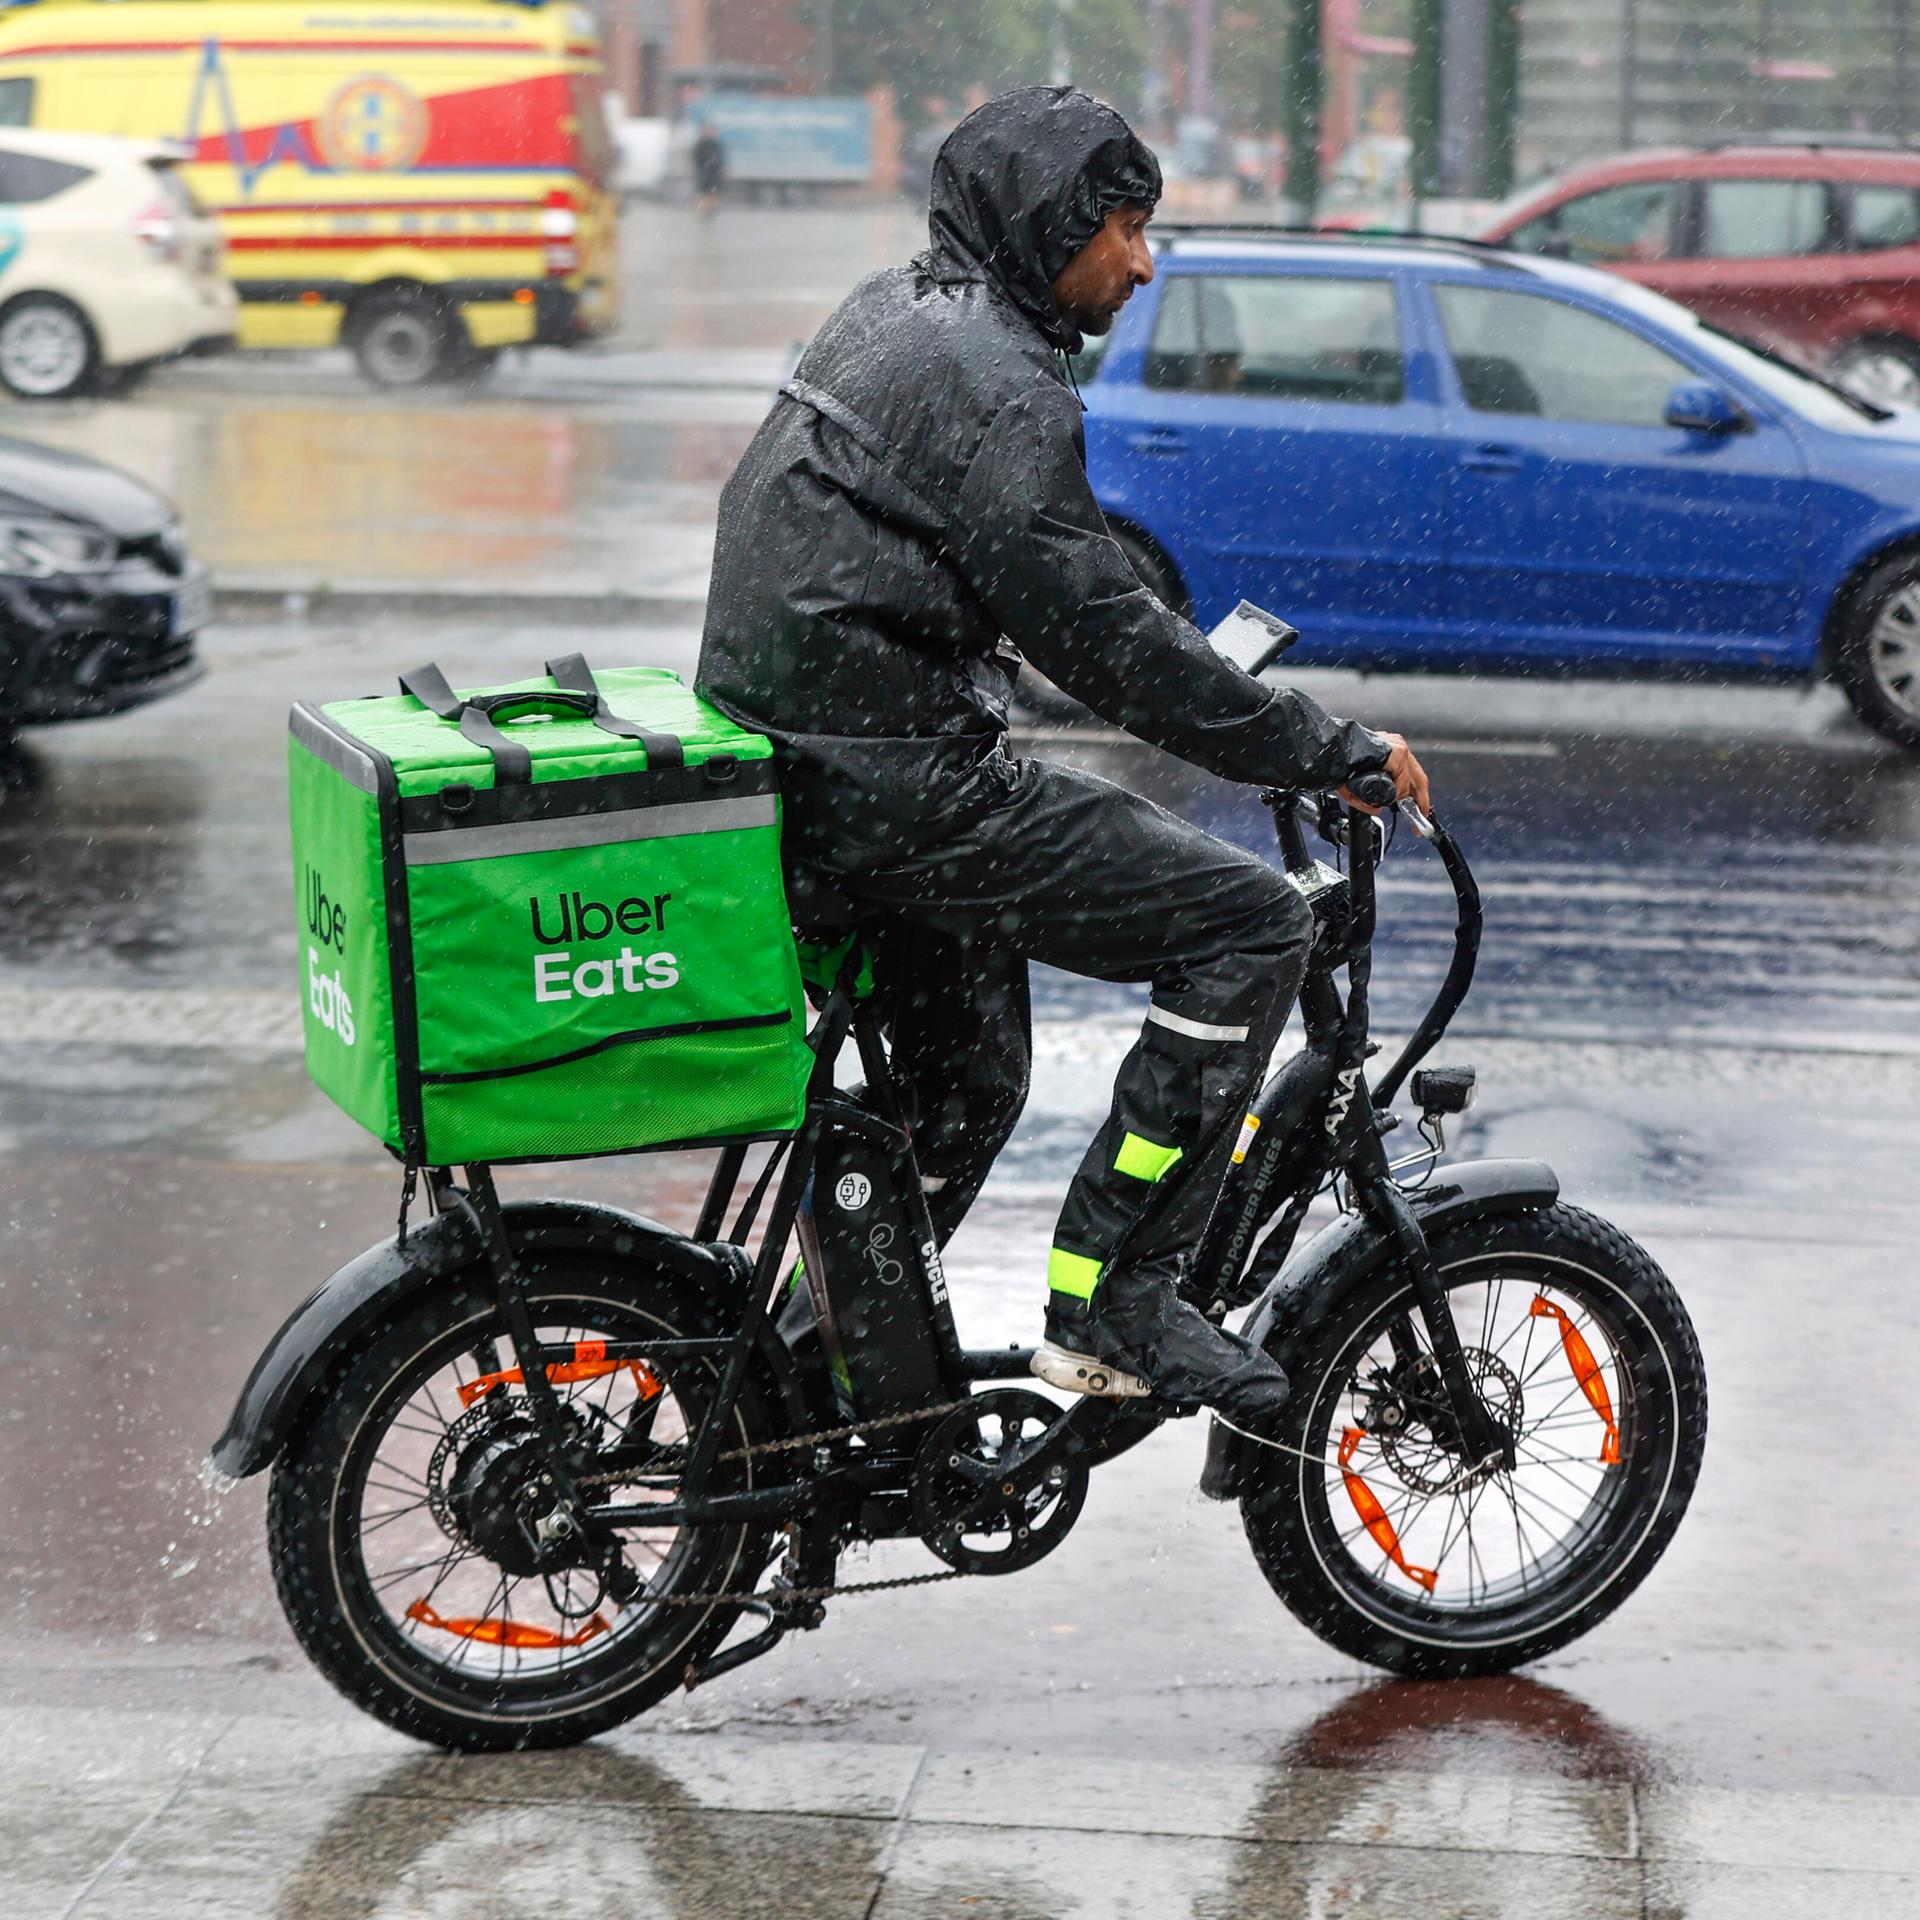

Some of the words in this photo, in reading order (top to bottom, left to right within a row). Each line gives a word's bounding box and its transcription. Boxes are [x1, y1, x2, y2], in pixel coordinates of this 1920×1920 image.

[529, 892, 673, 945] Uber
[307, 944, 356, 1047] Eats
[533, 946, 680, 1003] Eats
[1324, 1066, 1361, 1137] AXA
[1216, 1262, 1235, 1291] AD
[1227, 1192, 1262, 1262] POWER
[1253, 1136, 1283, 1193] BIKES
[921, 1240, 948, 1306] CYCLE
